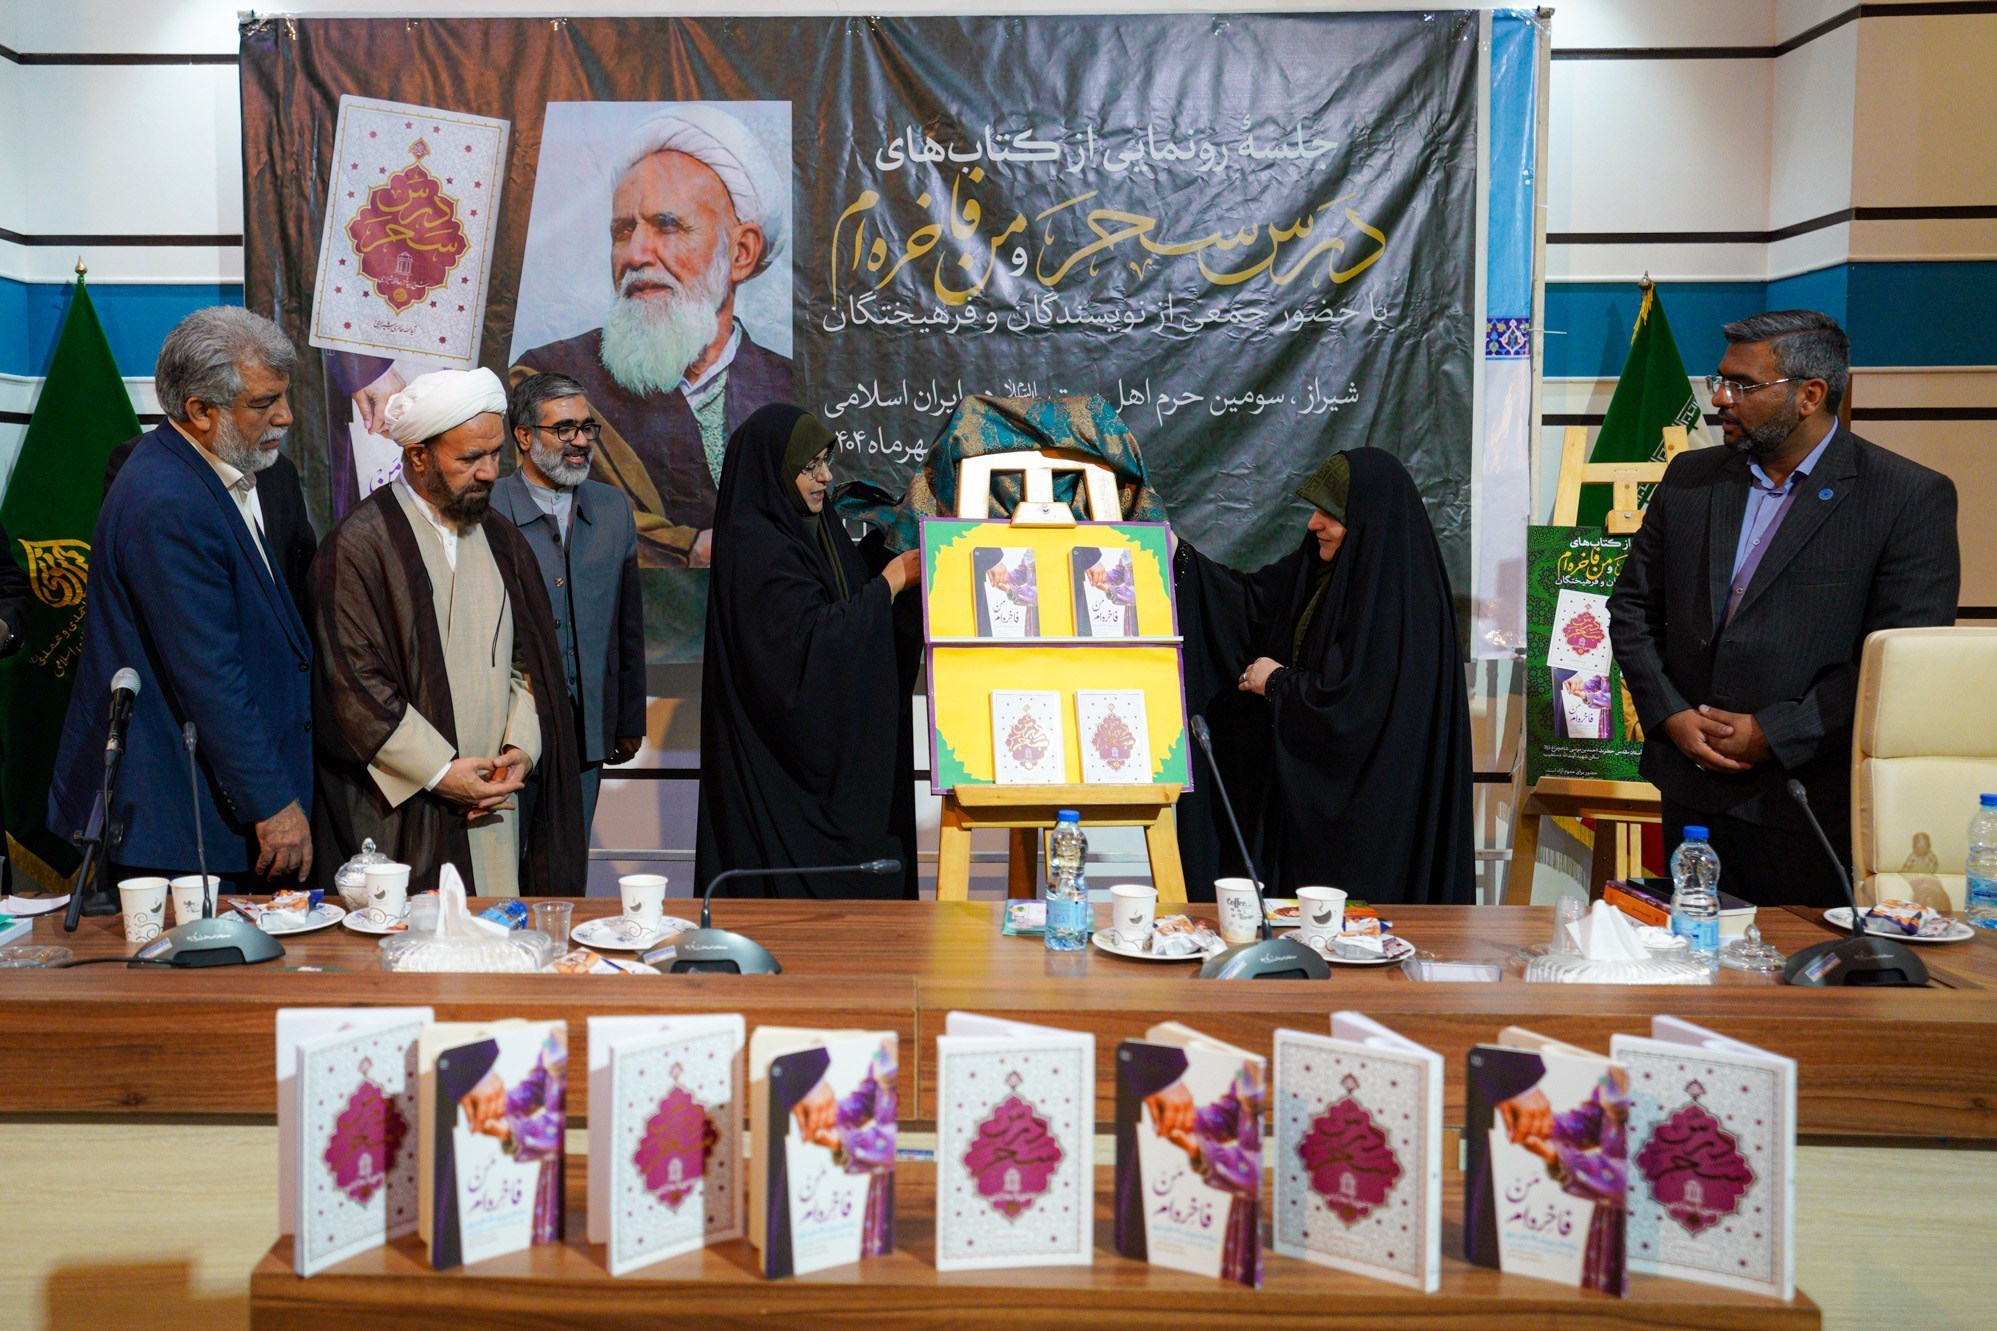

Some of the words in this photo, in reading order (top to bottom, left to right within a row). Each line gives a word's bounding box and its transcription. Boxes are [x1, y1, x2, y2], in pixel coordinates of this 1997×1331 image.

[1066, 123, 1094, 172] از
[1103, 123, 1229, 172] رونمایی
[934, 212, 1029, 306] من
[1008, 246, 1028, 277] و
[822, 290, 979, 333] فرهیختگان
[982, 309, 998, 333] و
[1007, 290, 1146, 333] نویسندگان
[1153, 292, 1174, 332] از
[1182, 301, 1270, 332] جمعی
[1277, 300, 1360, 332] حضور
[1369, 292, 1389, 330] با
[823, 378, 908, 419] اسلامی
[913, 378, 964, 416] ایران
[1115, 376, 1151, 414] اهل
[1155, 389, 1205, 427] حرم
[1209, 389, 1285, 416] سومین
[868, 426, 929, 463] هرماه
[1621, 537, 1632, 550] از
[1554, 574, 1599, 587] فرهیختگان
[1606, 565, 1613, 574] و
[1226, 897, 1246, 909] Coffee
